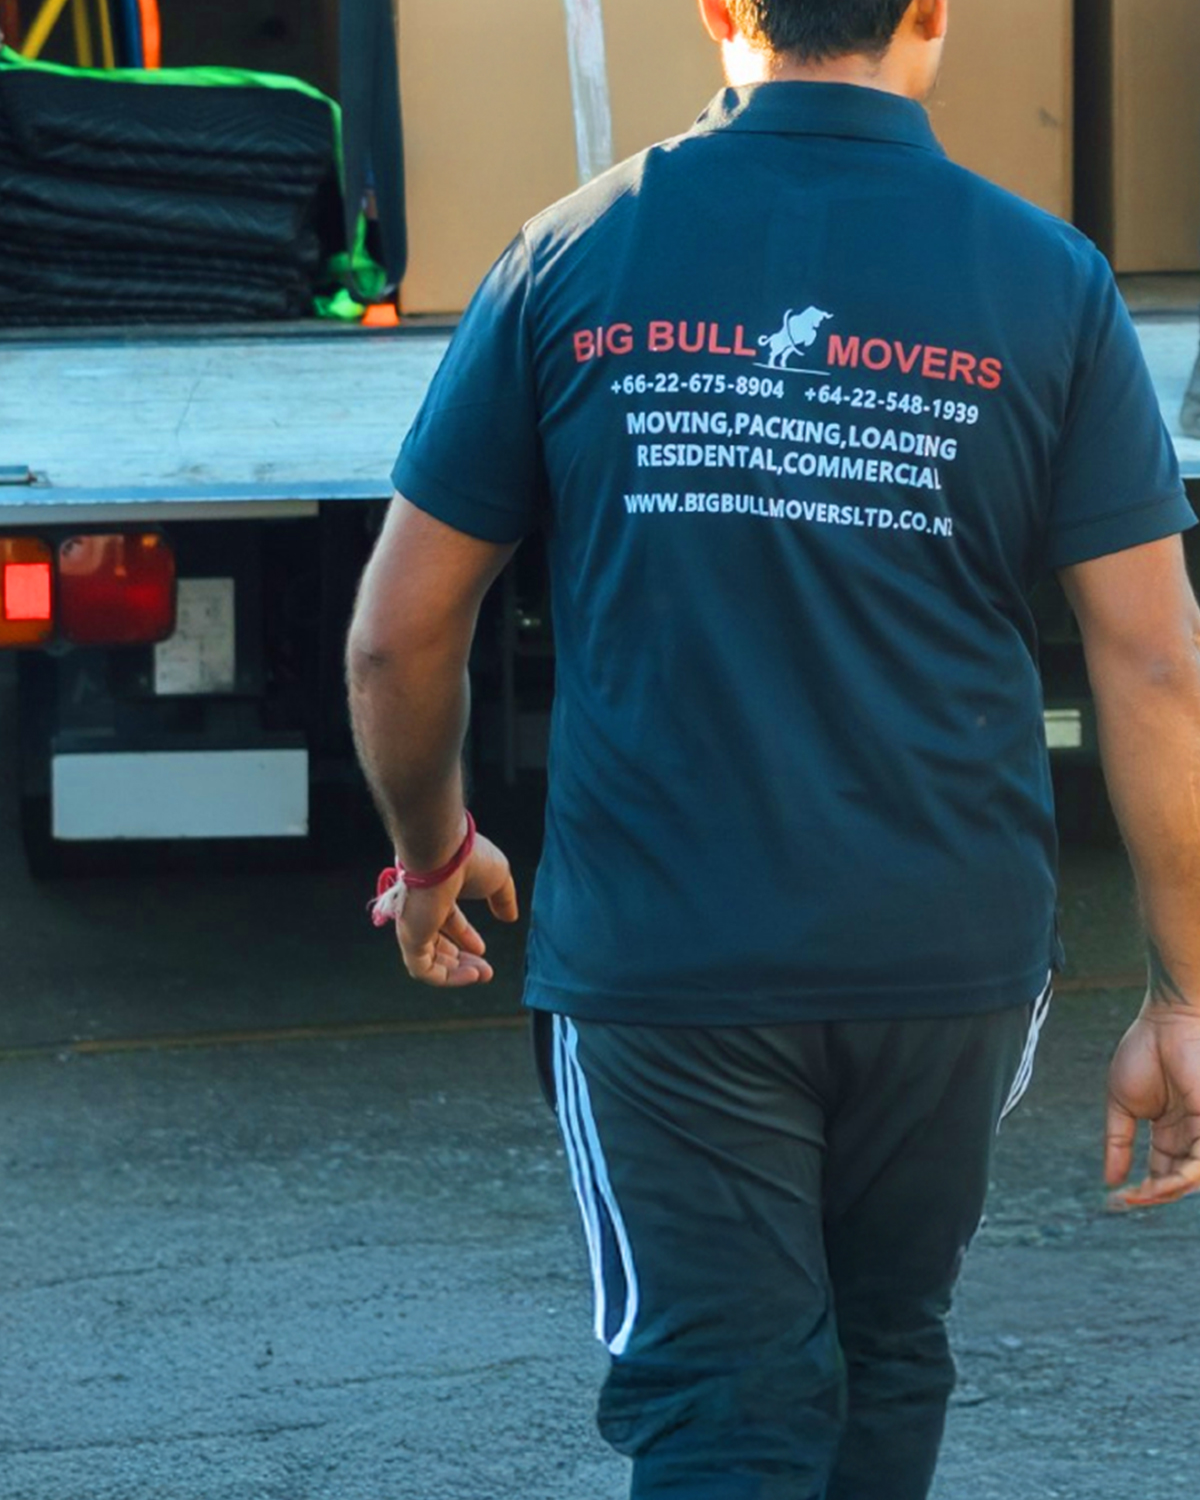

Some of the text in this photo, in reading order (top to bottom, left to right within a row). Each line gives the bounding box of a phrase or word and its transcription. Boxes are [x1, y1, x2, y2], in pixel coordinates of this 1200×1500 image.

[573, 320, 1003, 390] BIG BULL MOVERS
[610, 373, 979, 425] +66-22-675-8904 +64-22-548-1939
[626, 411, 957, 461] MOVING,PACKING,LOADING
